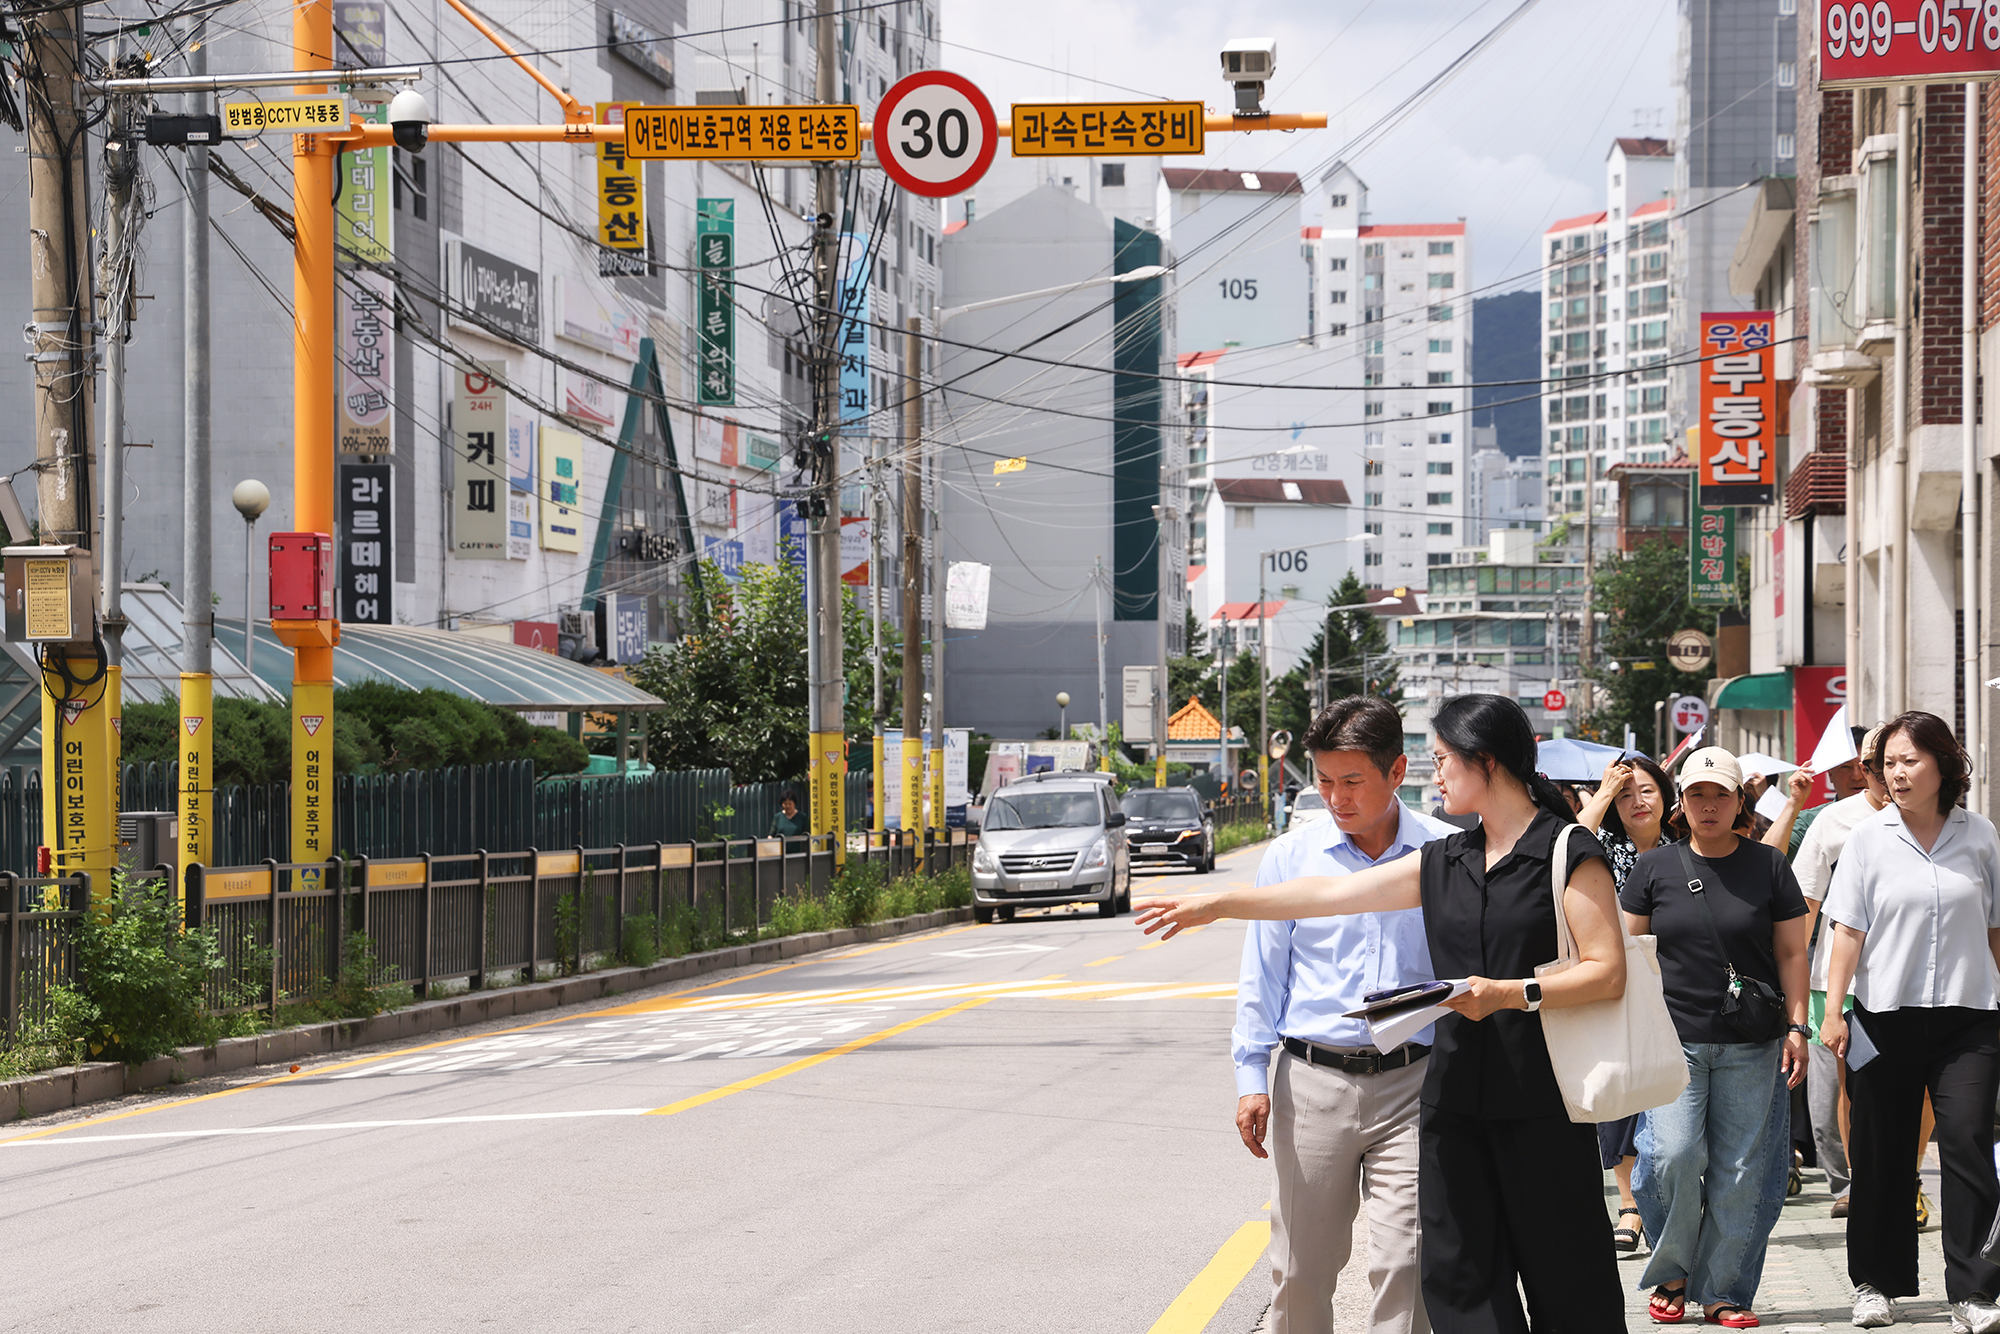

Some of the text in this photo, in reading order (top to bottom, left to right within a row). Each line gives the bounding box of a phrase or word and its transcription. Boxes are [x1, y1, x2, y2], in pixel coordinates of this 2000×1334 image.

[1826, 0, 2000, 59] 999-0578
[229, 104, 340, 126] 방범용 CCTV 작동중
[635, 114, 752, 152] 어린이보호구역
[759, 114, 792, 152] 적용
[798, 114, 849, 151] 단속중
[900, 108, 969, 159] 30
[1021, 109, 1195, 148] 과속단속장비
[1219, 279, 1258, 301] 105
[349, 291, 384, 376] 부동산
[1707, 323, 1771, 350] 우성
[348, 390, 387, 416] 뱅크
[470, 401, 492, 411] 24H
[1709, 352, 1767, 484] 부동산
[467, 432, 495, 513] 커피
[1267, 549, 1308, 573] 106
[618, 611, 643, 656] 부동산
[1705, 757, 1715, 768] LA
[187, 751, 199, 856] 어린이보호구역
[305, 750, 319, 851] 어린이보호구역
